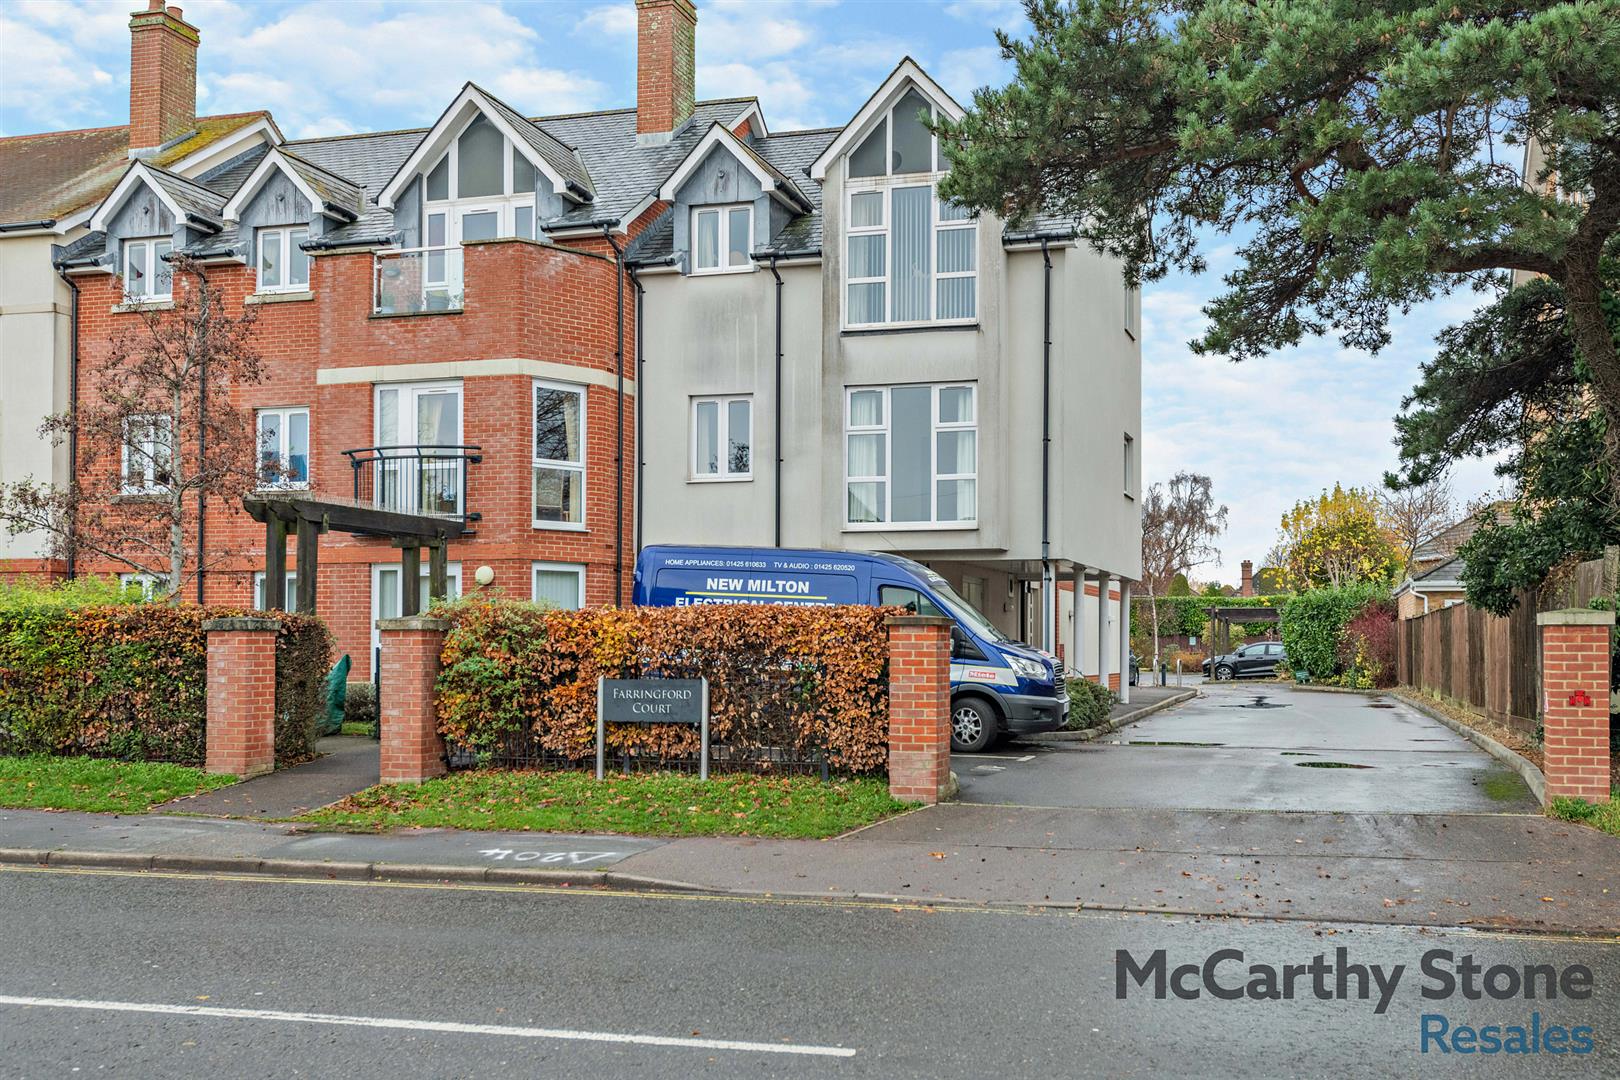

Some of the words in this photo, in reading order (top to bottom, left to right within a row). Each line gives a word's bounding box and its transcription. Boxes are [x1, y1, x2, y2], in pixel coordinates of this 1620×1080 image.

[684, 559, 725, 567] APPLIANCES:
[726, 560, 744, 568] 01425
[788, 562, 810, 570] AUDIO
[706, 577, 744, 591] NEW
[747, 579, 810, 593] MILTON
[613, 688, 692, 700] FARRINGFORD
[632, 702, 672, 714] COURT
